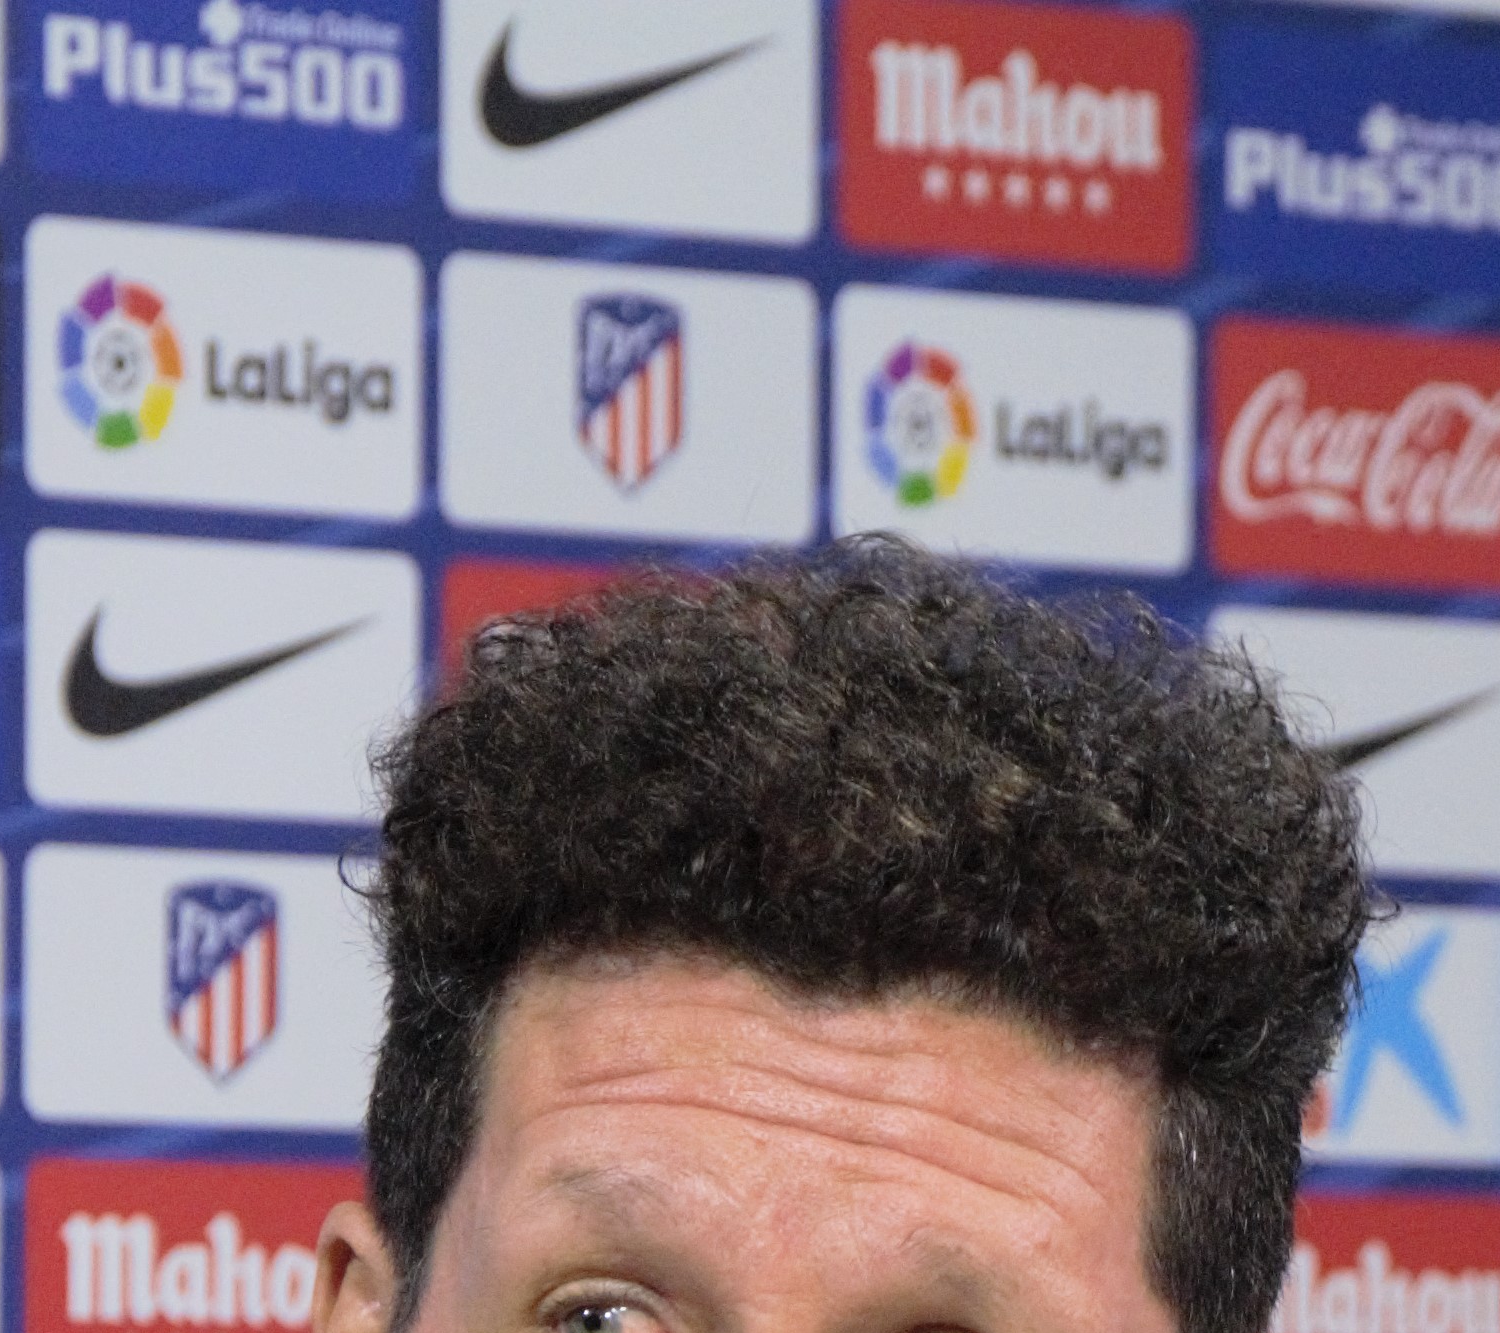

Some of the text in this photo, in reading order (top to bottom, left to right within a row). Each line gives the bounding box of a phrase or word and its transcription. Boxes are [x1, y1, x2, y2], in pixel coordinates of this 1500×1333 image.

[44, 14, 402, 131] Plus500
[871, 42, 1161, 169] Mahou
[205, 342, 394, 425] LaLiga
[62, 1213, 318, 1328] Maho
